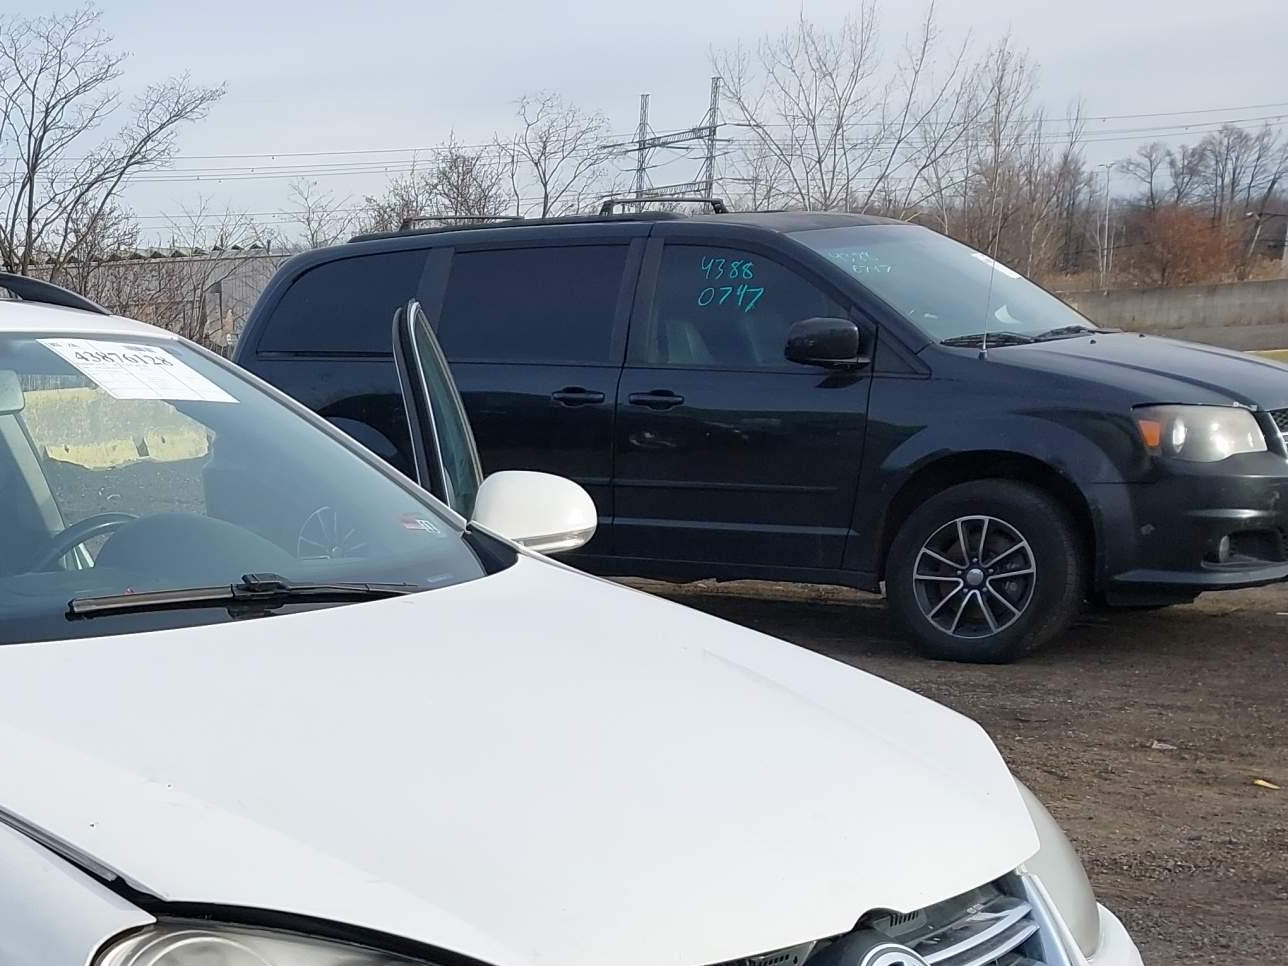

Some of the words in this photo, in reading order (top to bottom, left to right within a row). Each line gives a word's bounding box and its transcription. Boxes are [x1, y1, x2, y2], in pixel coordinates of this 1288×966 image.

[701, 256, 753, 279] 4388
[698, 285, 764, 312] 0747
[74, 351, 174, 367] 43876128
